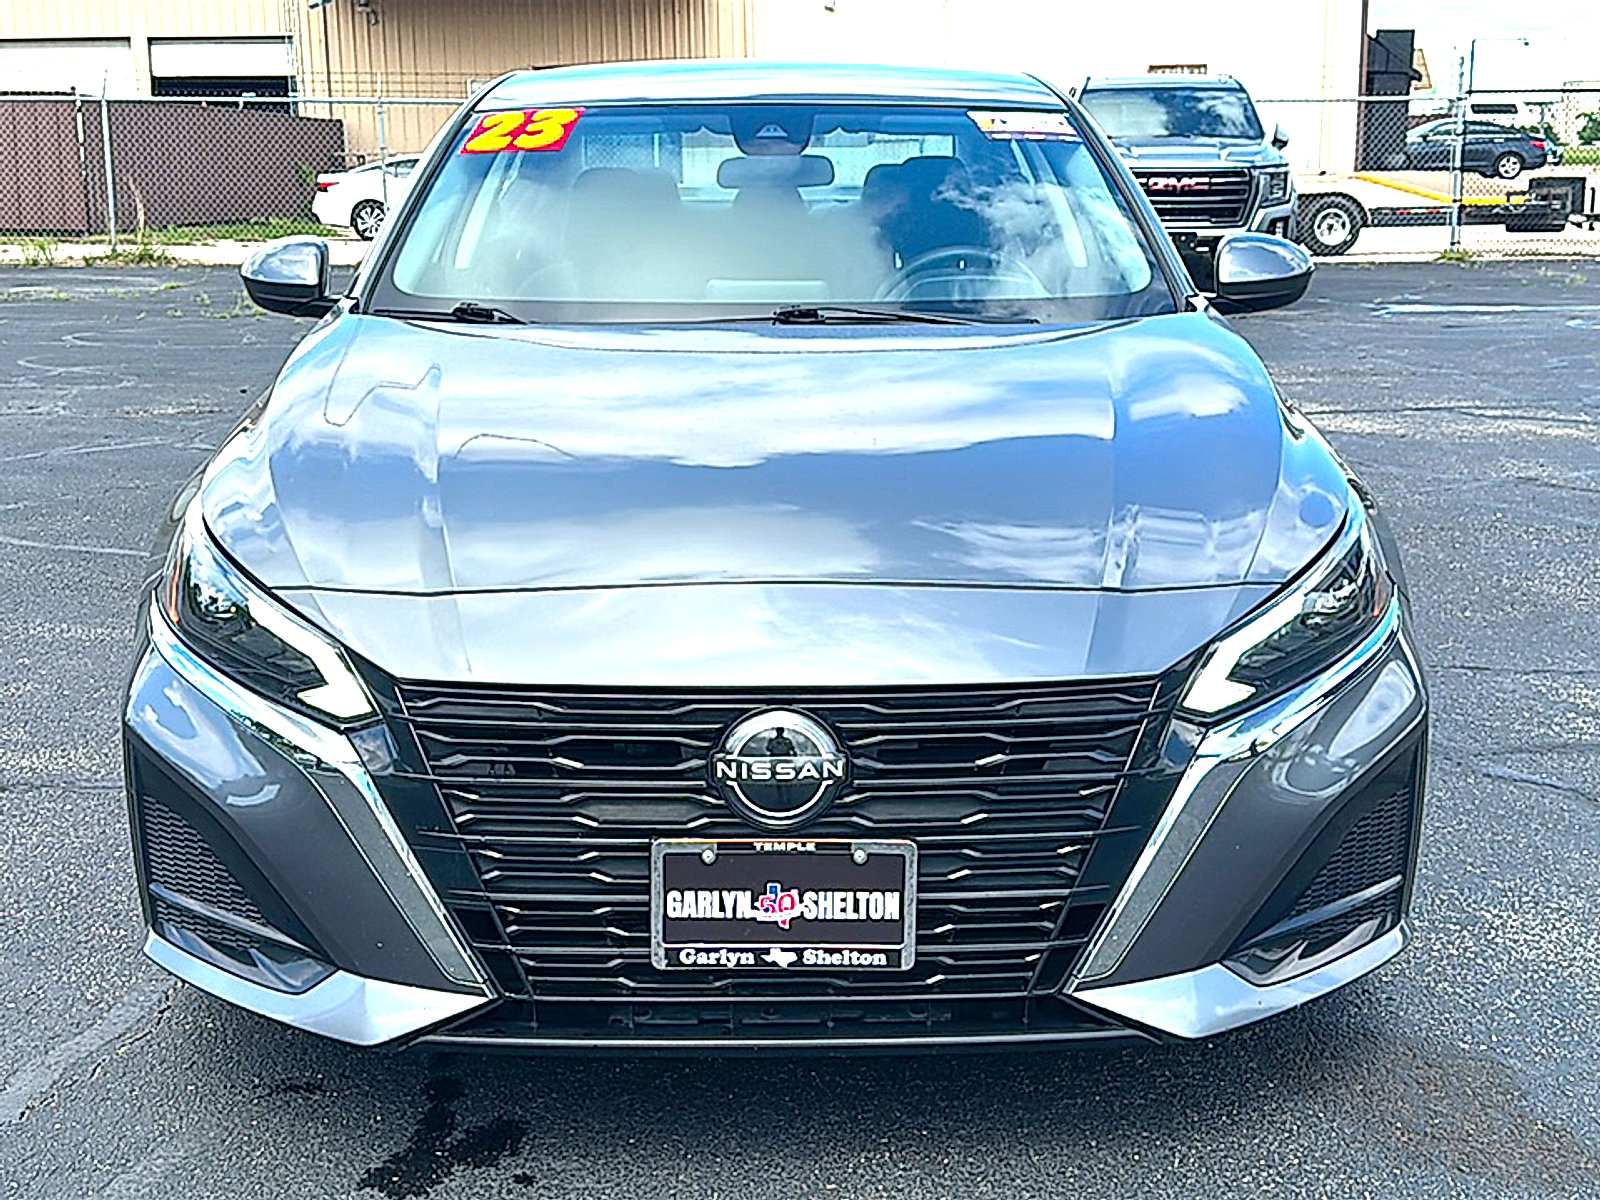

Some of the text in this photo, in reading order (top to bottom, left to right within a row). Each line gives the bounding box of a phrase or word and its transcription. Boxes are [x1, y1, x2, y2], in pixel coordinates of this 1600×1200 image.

[465, 109, 578, 151] 23
[1148, 177, 1210, 190] GMC
[716, 761, 844, 780] NISSAN
[753, 841, 816, 852] TEMPLE
[666, 890, 752, 919] GARLYN
[802, 891, 900, 920] SHELTON
[679, 948, 888, 967] Garlyn Shelton
